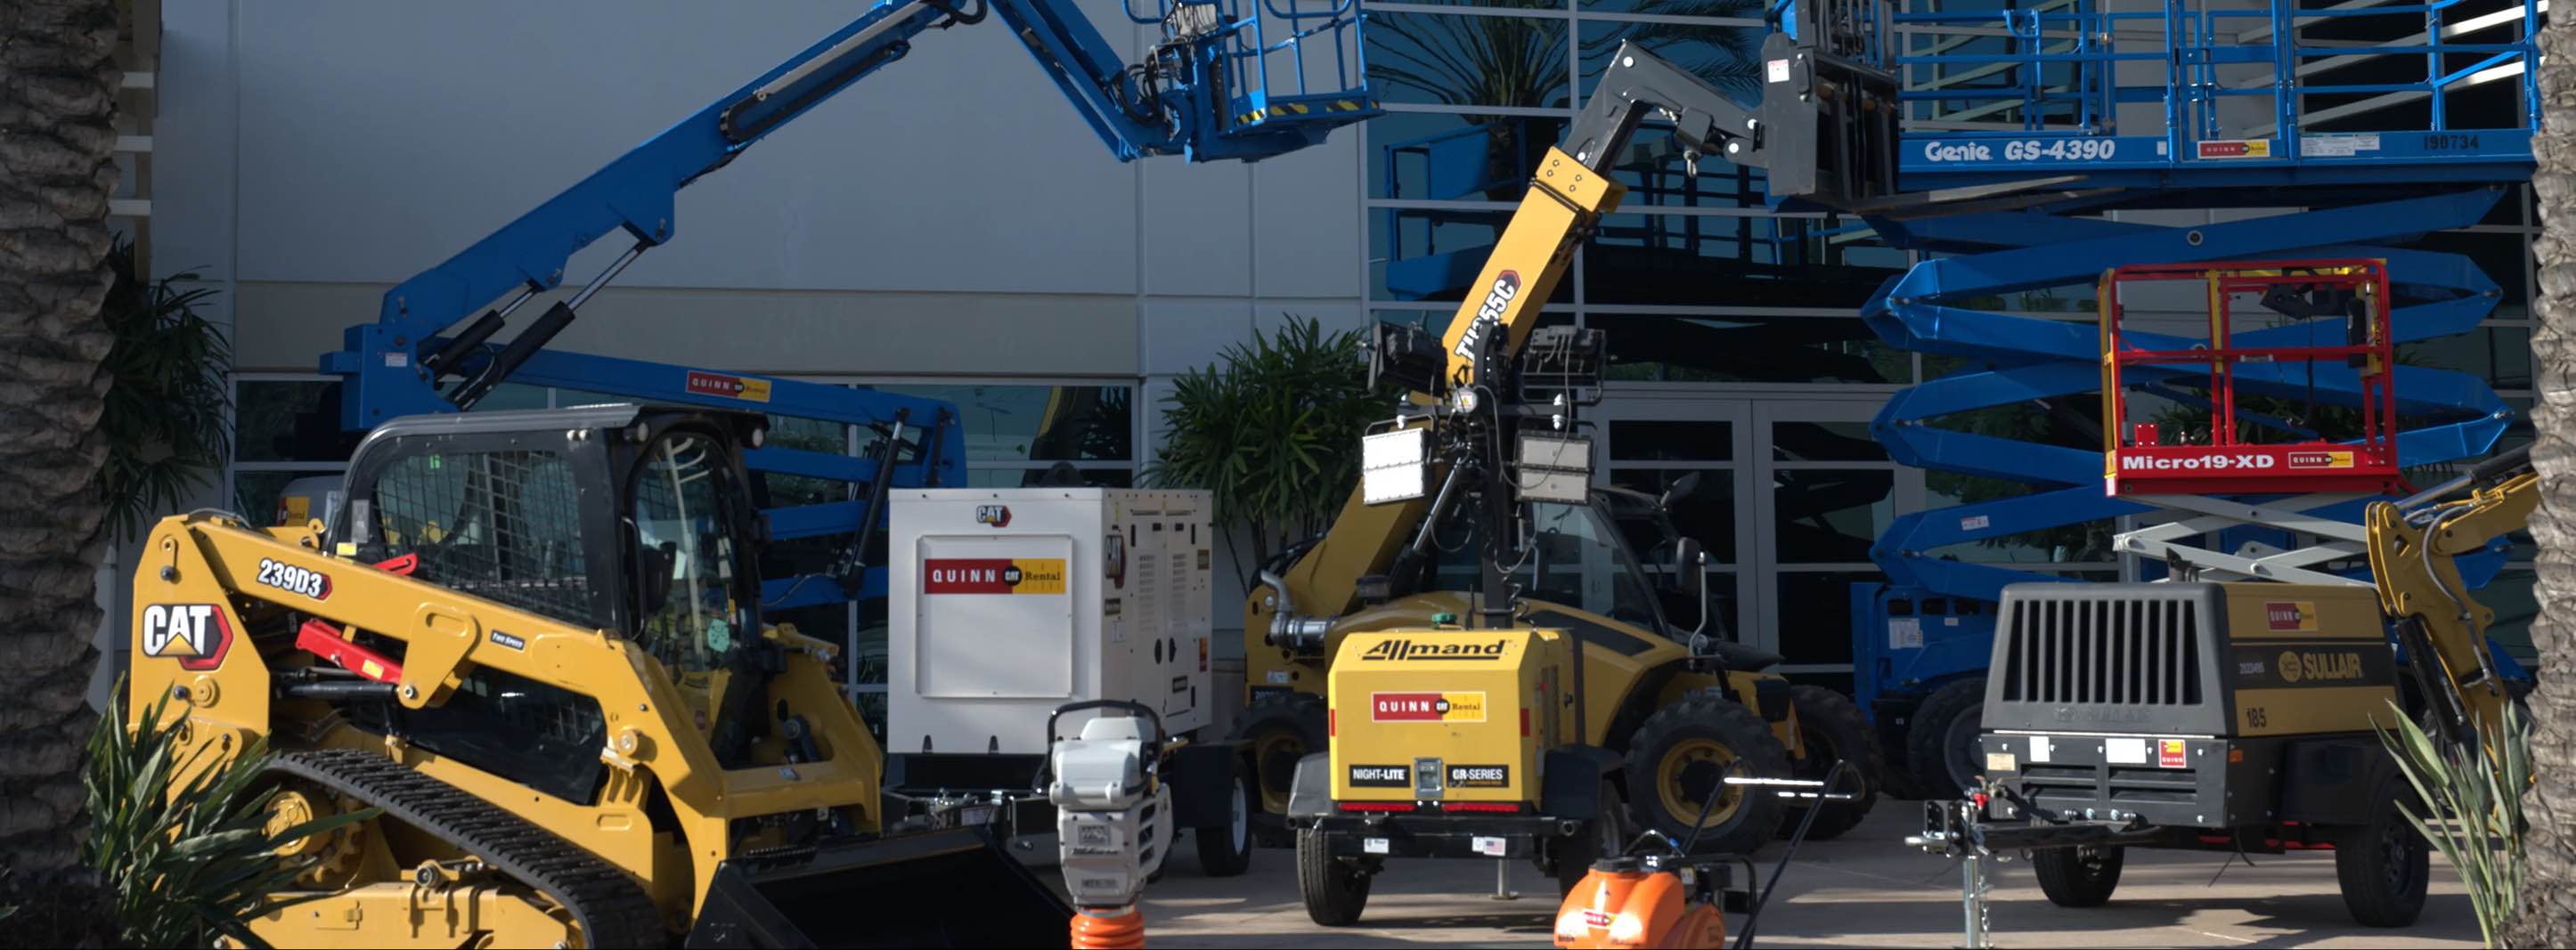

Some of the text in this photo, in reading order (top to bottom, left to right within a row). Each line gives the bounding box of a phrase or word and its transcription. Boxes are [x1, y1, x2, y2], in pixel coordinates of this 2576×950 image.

[1925, 139, 2115, 161] Genie GS-4390
[692, 378, 730, 390] QUINN
[2123, 454, 2274, 470] Micro19-XD
[978, 506, 1003, 523] CAT
[258, 558, 323, 598] 239D3
[933, 570, 1061, 583] QUINN CAT Rental
[143, 605, 212, 656] CAT
[1366, 639, 1506, 661] Allmand
[2303, 652, 2363, 680] SULLAIR
[1379, 701, 1430, 712] QUINN
[1452, 702, 1480, 711] Rental
[2246, 707, 2267, 727] 185
[1352, 768, 1405, 781] NIGHT-LITE
[1452, 768, 1504, 781] CR-SERIES
